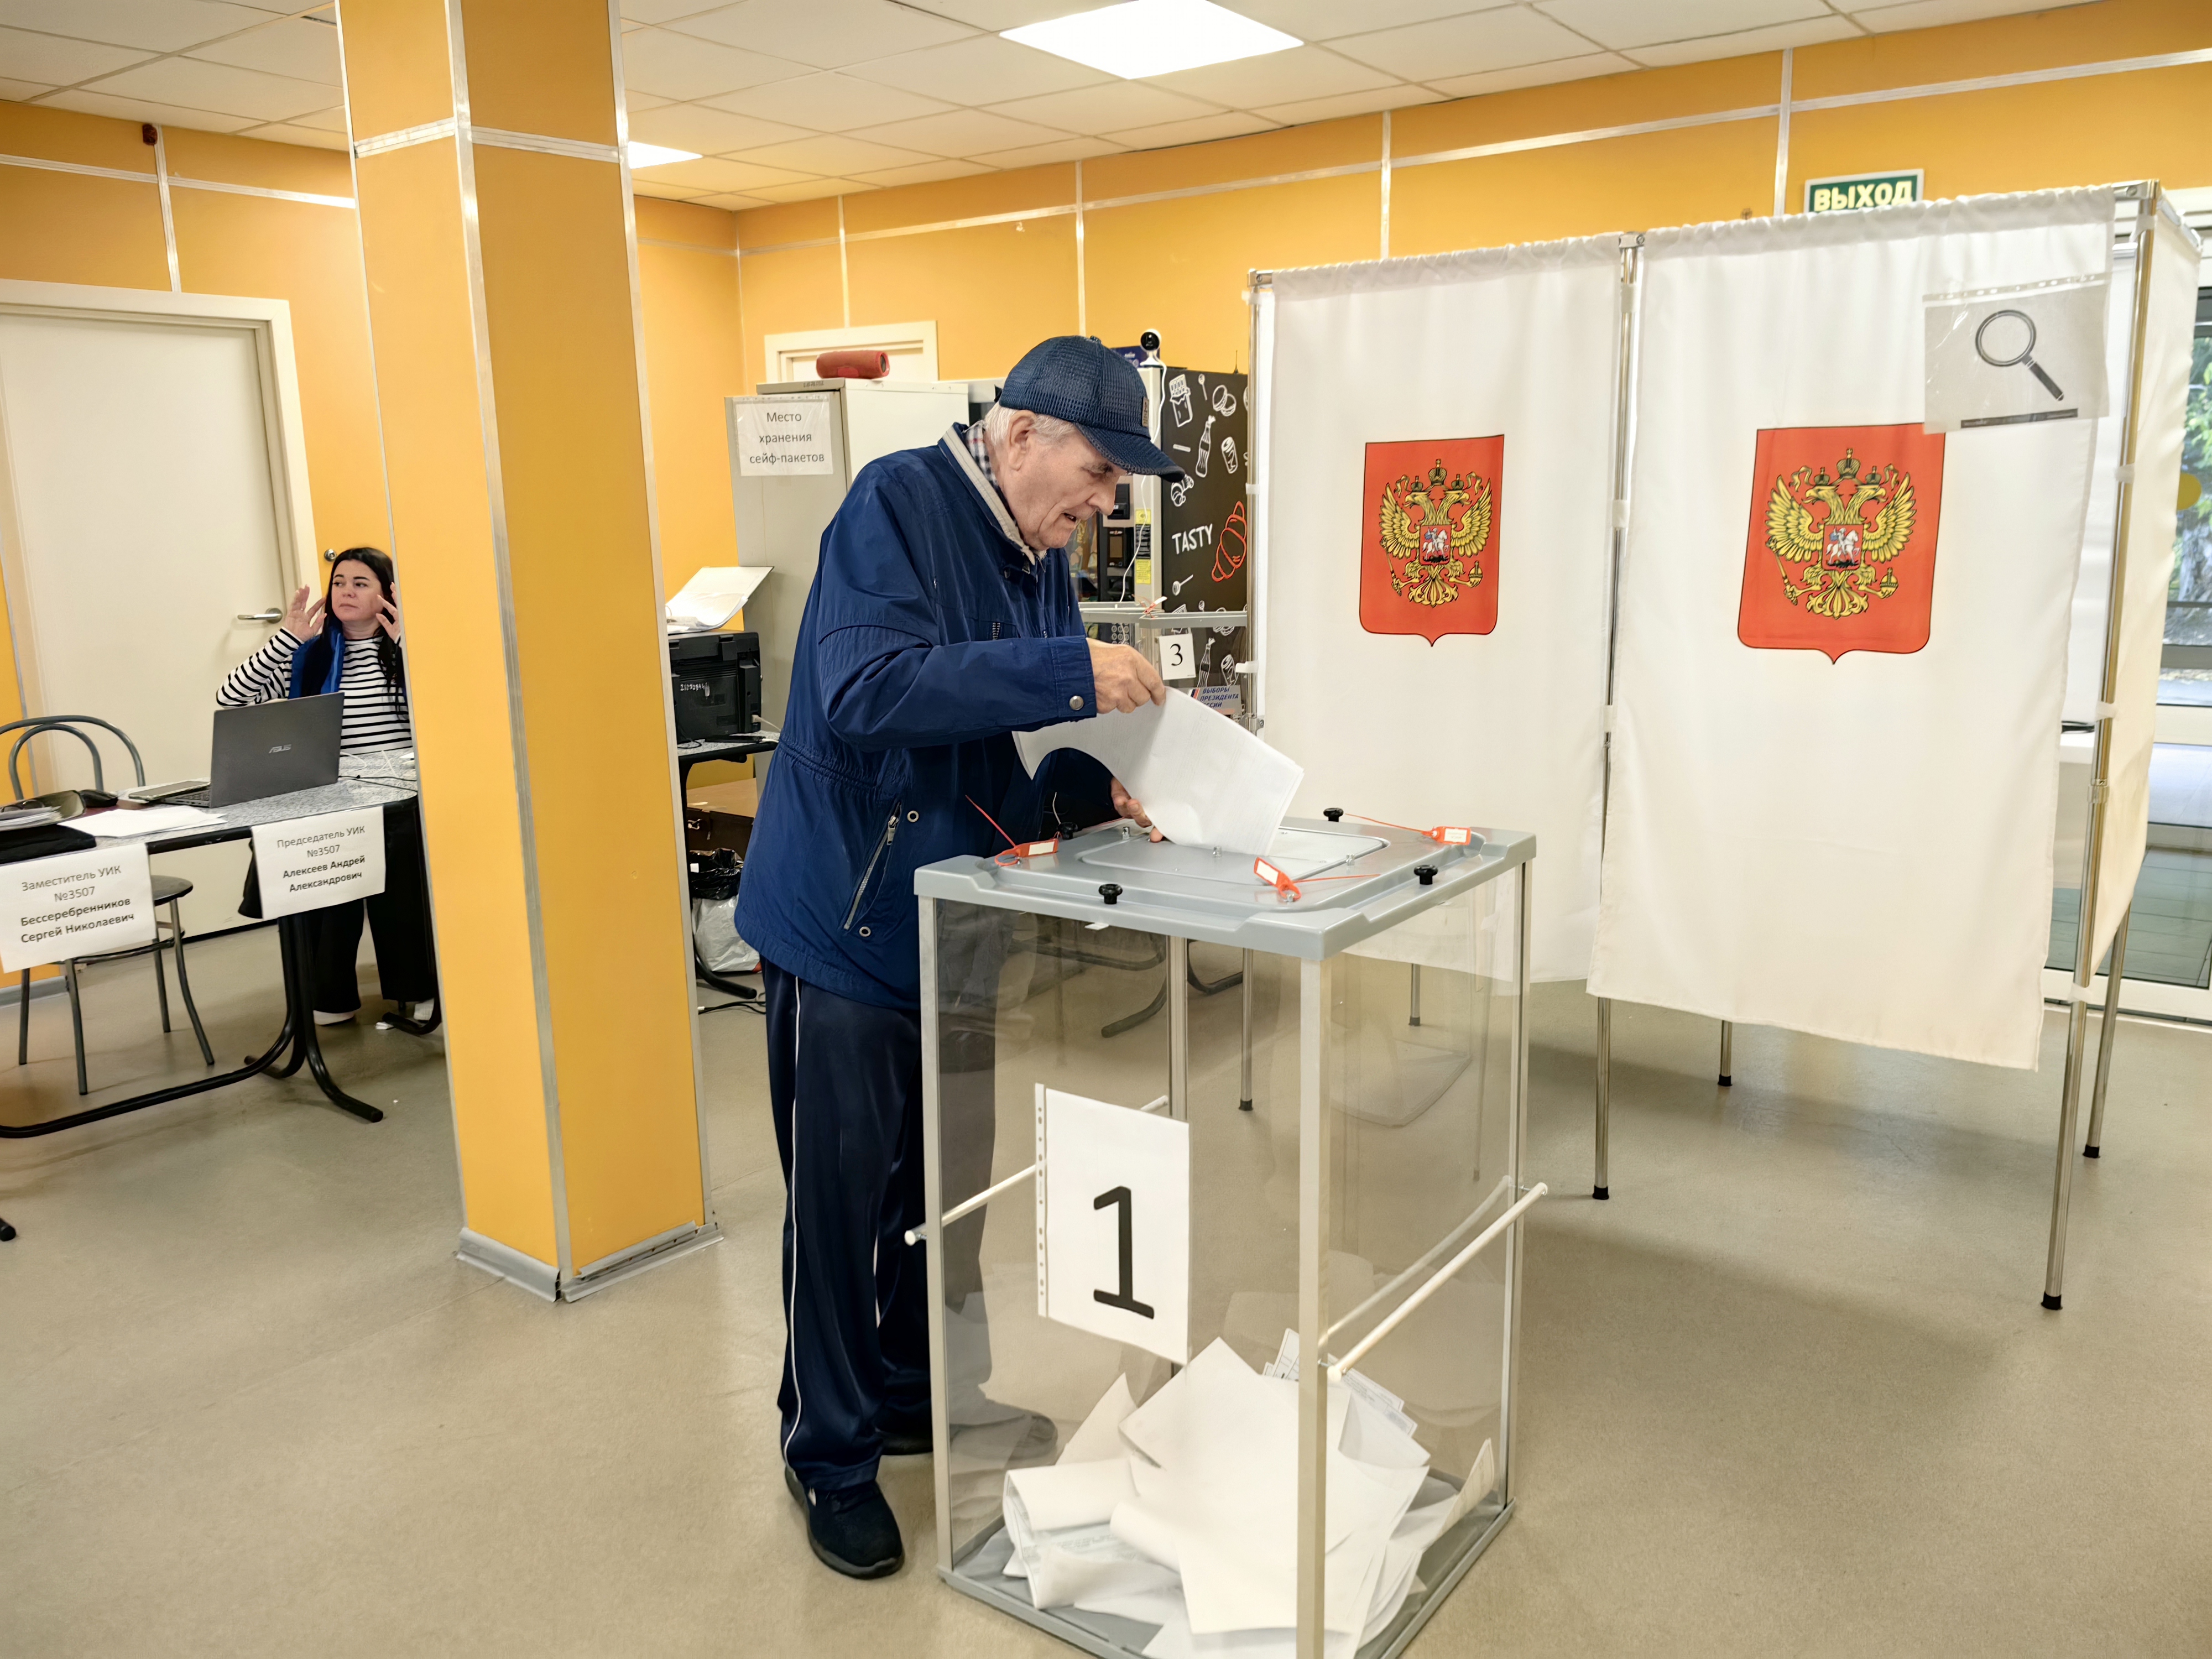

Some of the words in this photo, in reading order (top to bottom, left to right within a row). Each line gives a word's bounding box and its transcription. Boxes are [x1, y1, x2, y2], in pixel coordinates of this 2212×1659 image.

[1814, 180, 1912, 211] ВЫХОД
[766, 412, 802, 422] Место
[759, 434, 812, 445] хранения
[749, 453, 825, 465] сейф-пакетов
[1171, 523, 1213, 555] TASTY
[1170, 643, 1183, 666] 3
[269, 744, 292, 754] ASUS
[277, 830, 345, 848] Председатель
[347, 826, 366, 837] УИК
[307, 844, 341, 858] №3507
[21, 872, 96, 891] Заместитель
[98, 865, 122, 878] УИК
[283, 864, 328, 879] Алексеев
[330, 855, 366, 869] Андрей
[289, 872, 362, 893] Александрович
[54, 886, 96, 902] №3507
[20, 898, 131, 927] Бессеребренников
[20, 926, 63, 943] Сергей
[66, 913, 134, 934] Николаевич
[1093, 1185, 1155, 1319] 1
